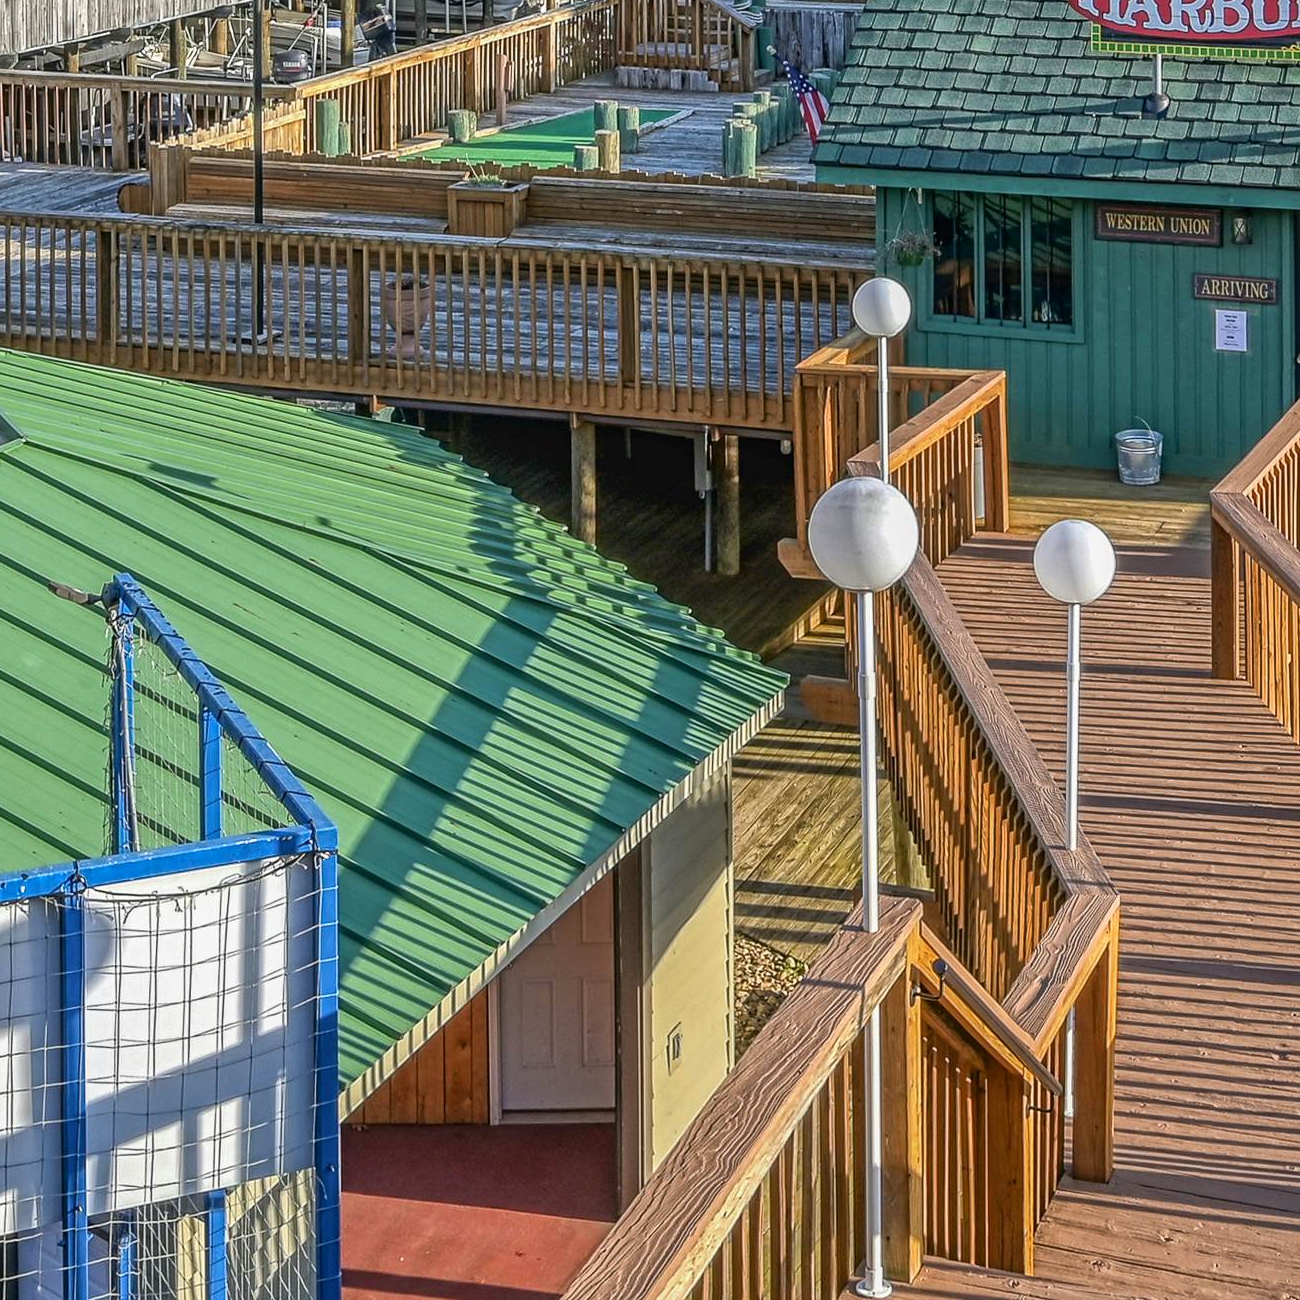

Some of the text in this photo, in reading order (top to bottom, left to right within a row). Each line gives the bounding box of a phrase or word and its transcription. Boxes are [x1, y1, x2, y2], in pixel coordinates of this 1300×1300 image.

[1105, 212, 1211, 235] WESTERN UNION
[1201, 279, 1269, 299] ARRIVING
